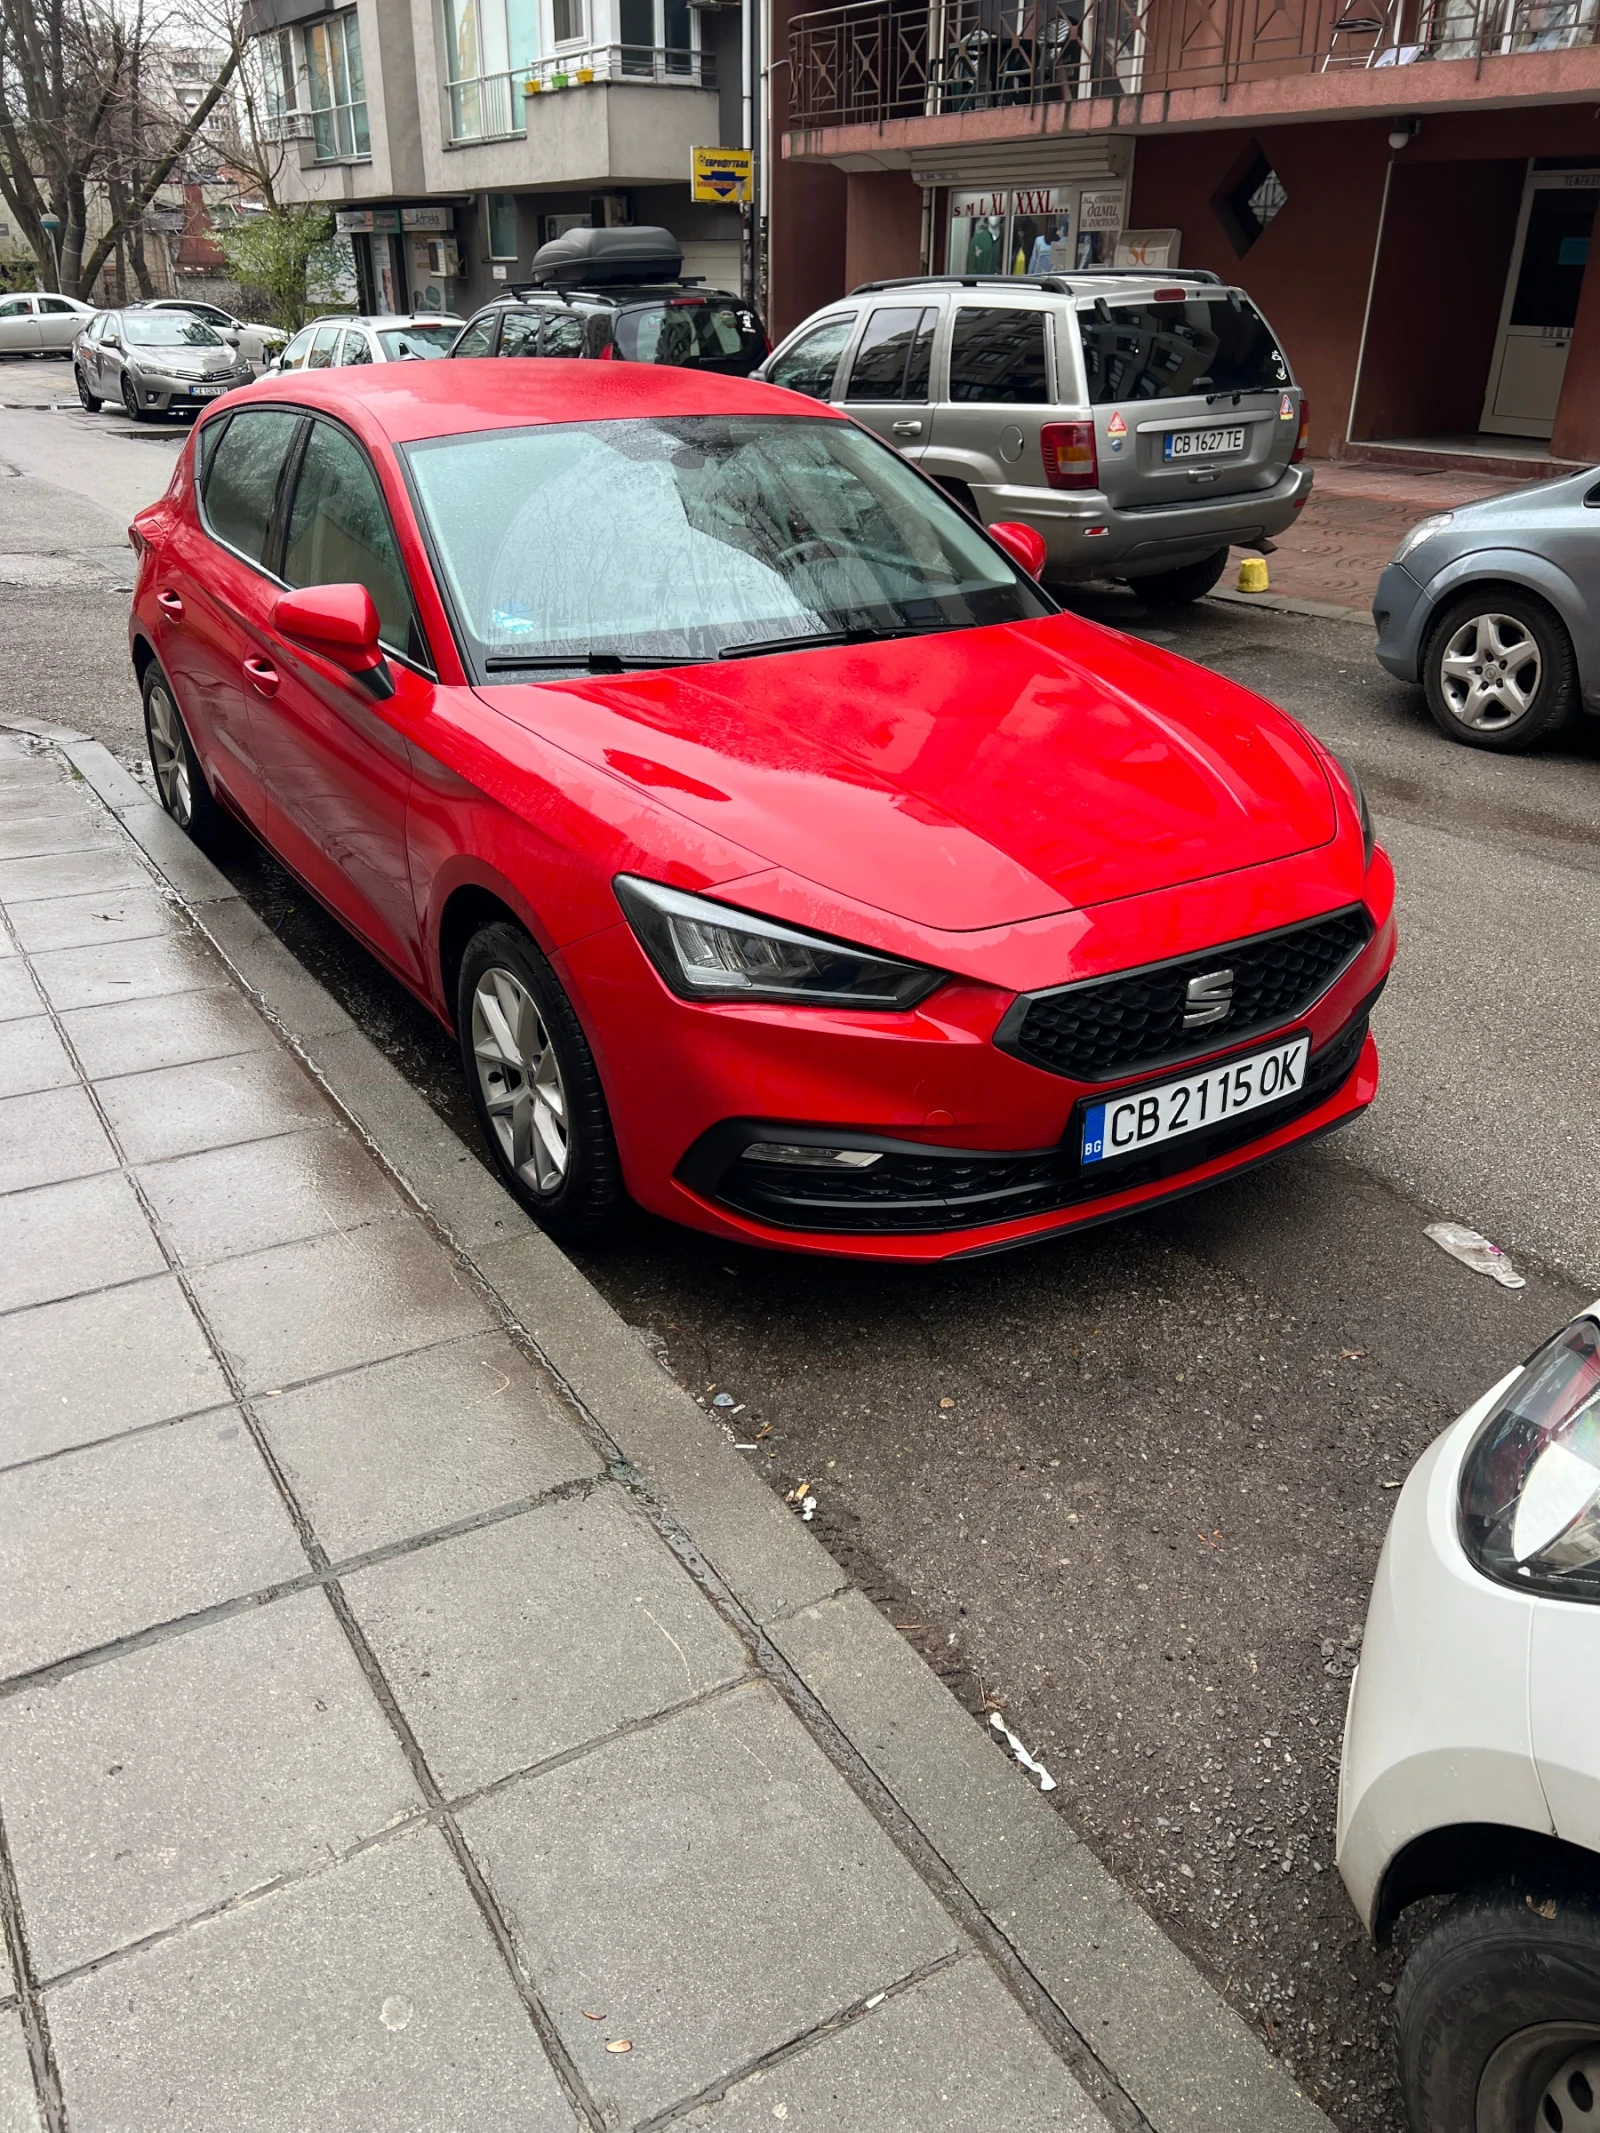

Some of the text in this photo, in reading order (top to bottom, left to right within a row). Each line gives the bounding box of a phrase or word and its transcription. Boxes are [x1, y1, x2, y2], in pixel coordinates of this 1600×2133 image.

[954, 206, 961, 216] S
[966, 203, 975, 216] M
[980, 198, 987, 216] L
[990, 192, 1005, 215] XL
[1087, 202, 1118, 218] дами
[1174, 430, 1242, 454] CB 1627 TE
[1084, 1045, 1302, 1156] BG CB 2115 OK
